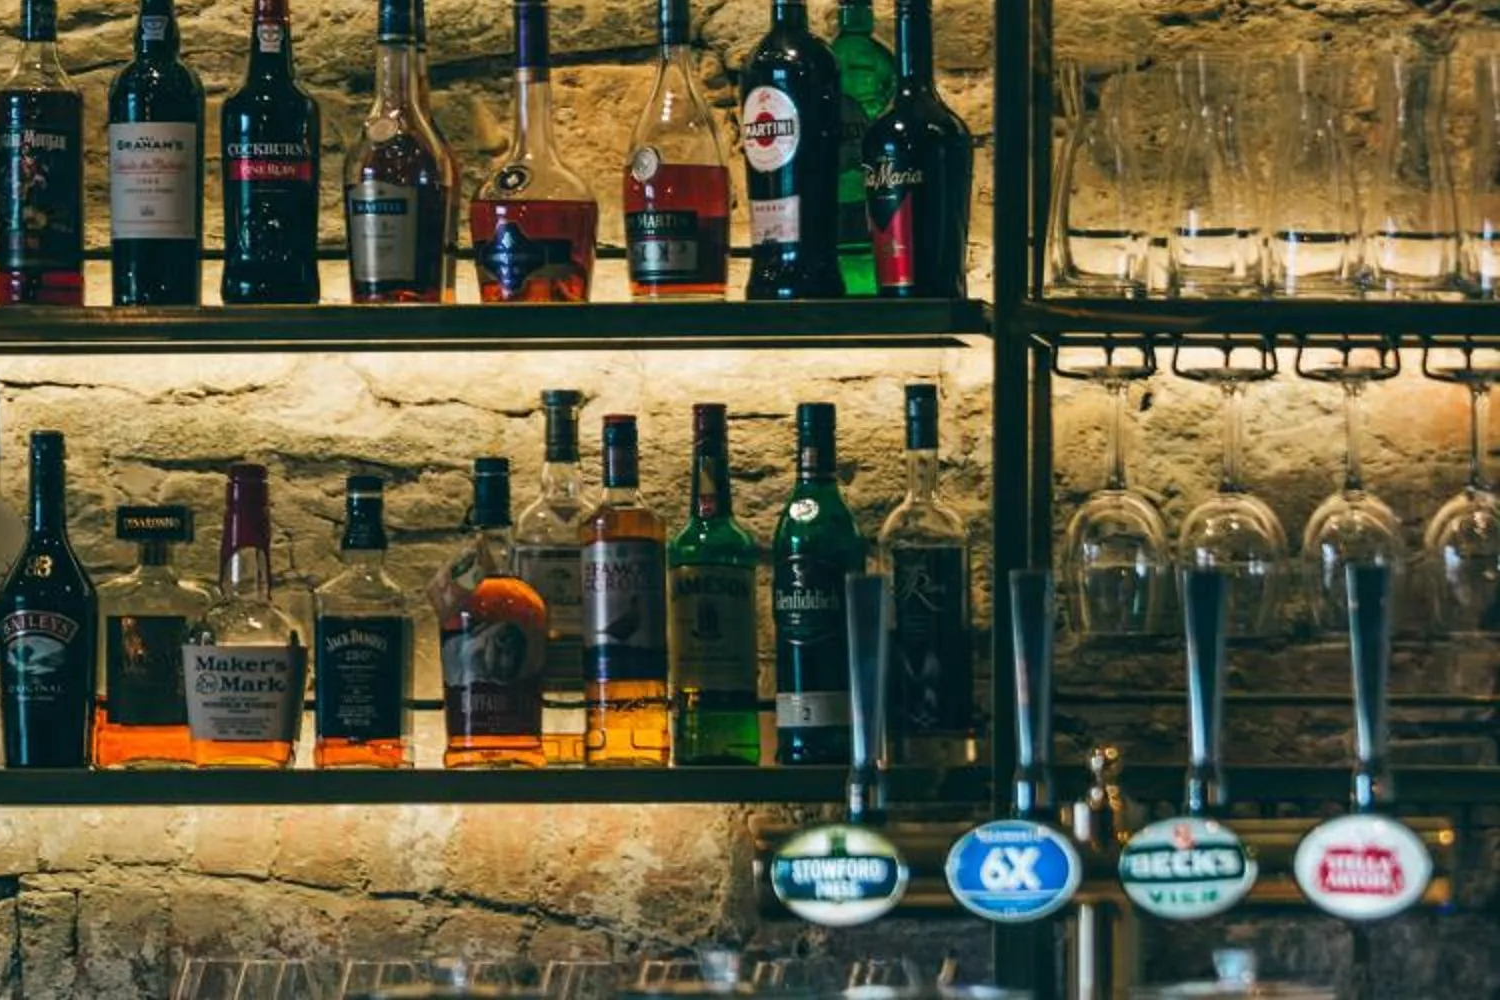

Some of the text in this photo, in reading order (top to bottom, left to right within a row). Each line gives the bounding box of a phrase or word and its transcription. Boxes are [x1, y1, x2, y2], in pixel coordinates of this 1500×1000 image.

[745, 120, 793, 138] MARTINI
[776, 588, 839, 610] lenfiddich
[4, 614, 69, 635] BAILEYS
[195, 655, 288, 674] Maker's
[220, 674, 285, 693] Mark
[980, 846, 1042, 891] 6X
